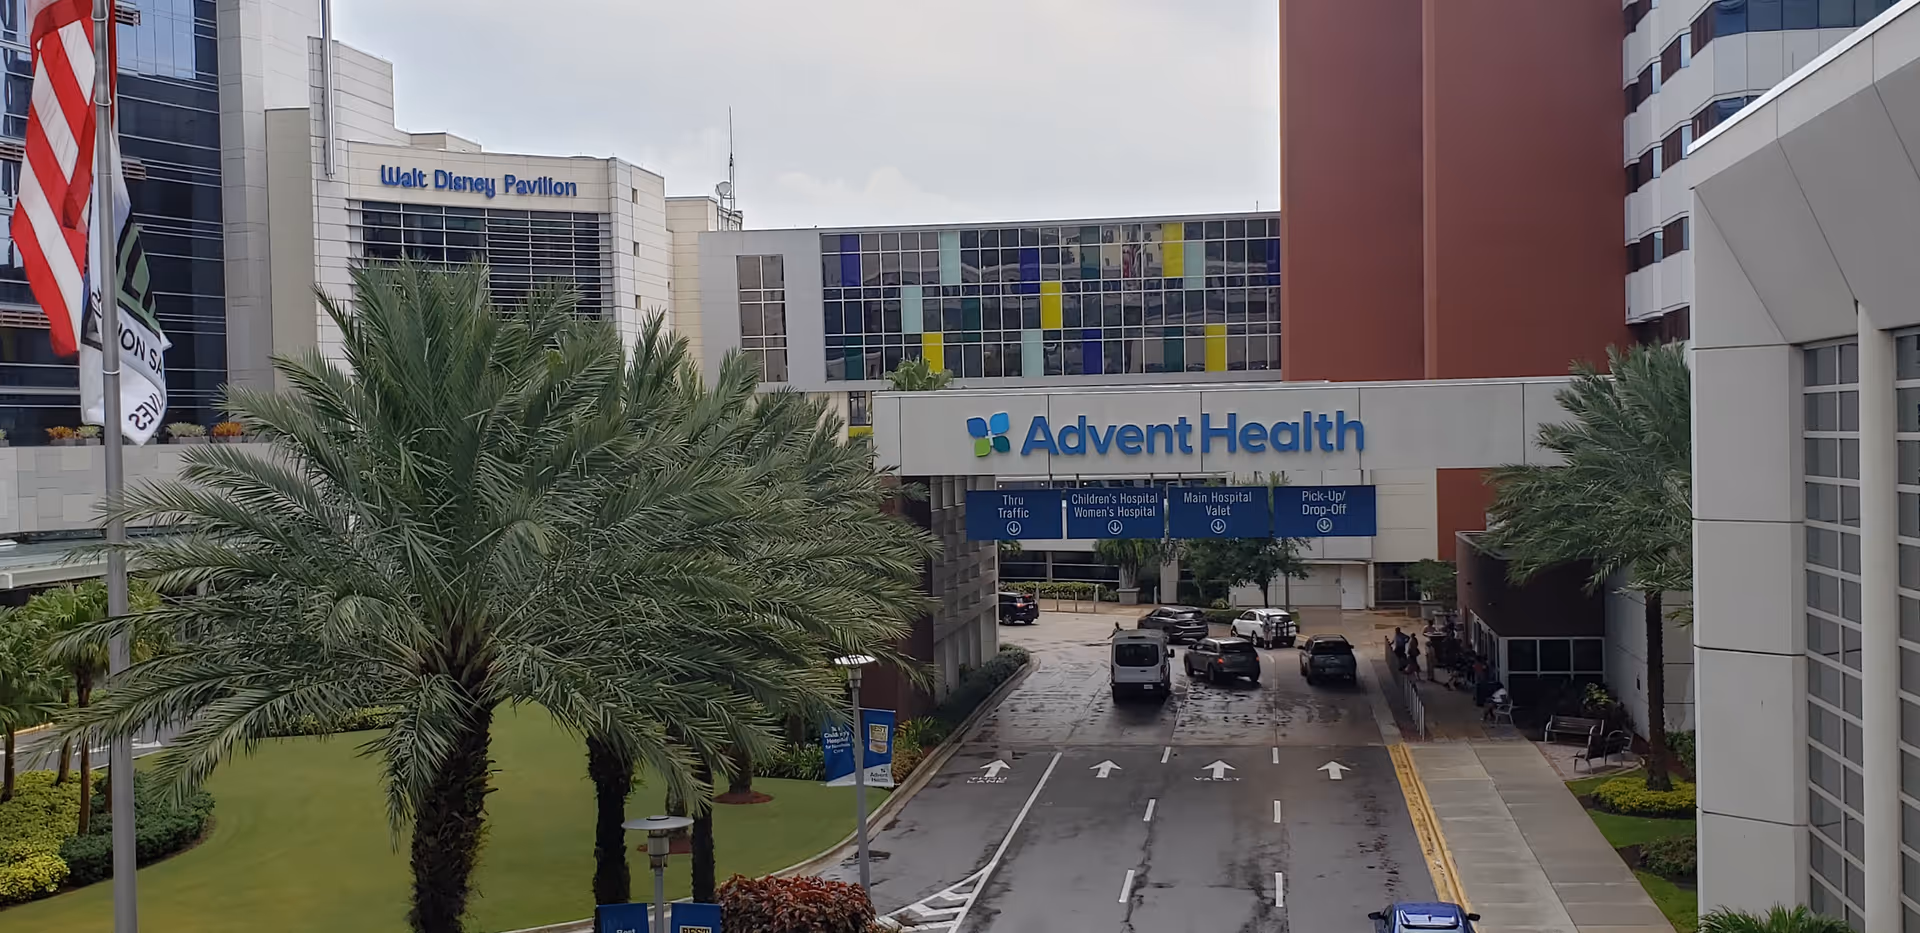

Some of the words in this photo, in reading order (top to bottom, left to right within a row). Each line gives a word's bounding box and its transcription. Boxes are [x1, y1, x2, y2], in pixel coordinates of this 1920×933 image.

[380, 164, 428, 188] Walt
[434, 169, 496, 199] Disney
[504, 174, 577, 197] Pavilion
[1002, 494, 1024, 505] Thru
[1071, 493, 1117, 505] Children's
[1120, 492, 1158, 505] Hospital
[1183, 492, 1207, 503] Main
[1211, 491, 1252, 504] Hospital
[1302, 490, 1346, 503] Pick-Up/
[997, 507, 1030, 519] Traffic
[1074, 506, 1114, 518] Women's
[1117, 506, 1156, 519] Hospital
[1205, 505, 1231, 516] Valet
[1302, 503, 1347, 517] Drop-Off
